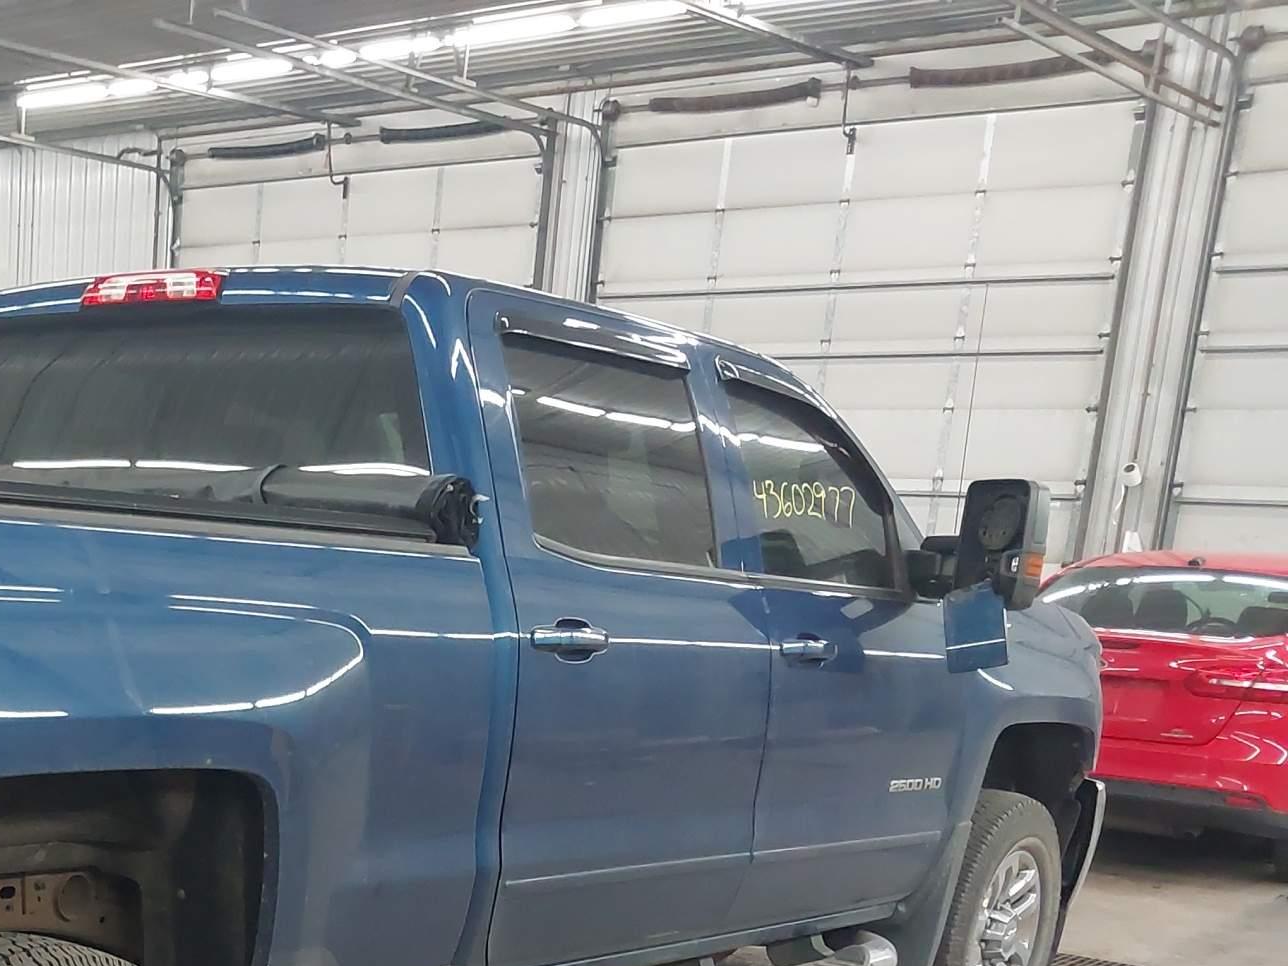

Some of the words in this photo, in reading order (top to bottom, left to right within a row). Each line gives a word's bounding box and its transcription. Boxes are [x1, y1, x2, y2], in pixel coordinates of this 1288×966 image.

[752, 479, 856, 529] 43602977
[889, 779, 923, 793] 2500
[924, 777, 942, 790] HD
